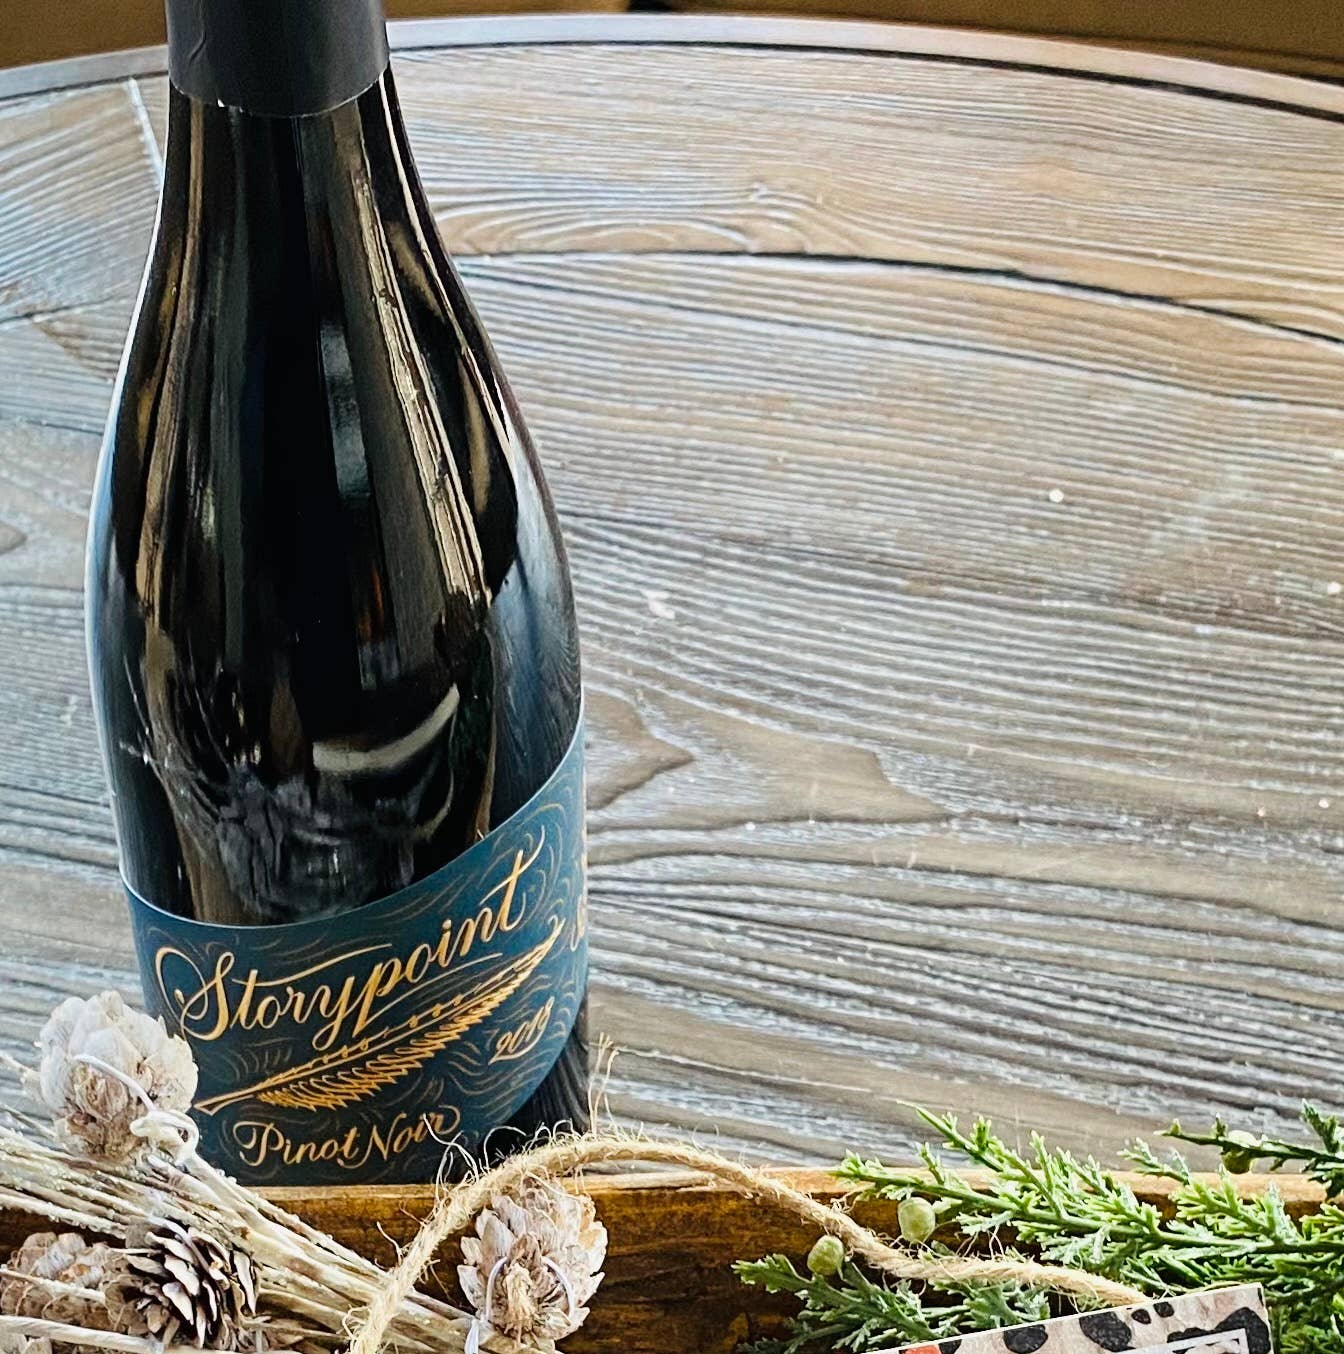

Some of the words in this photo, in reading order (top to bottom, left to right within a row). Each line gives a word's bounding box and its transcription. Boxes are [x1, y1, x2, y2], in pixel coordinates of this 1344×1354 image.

[156, 824, 545, 1050] Storypoint
[233, 1120, 360, 1167] Pinot
[340, 1104, 460, 1169] Noir
